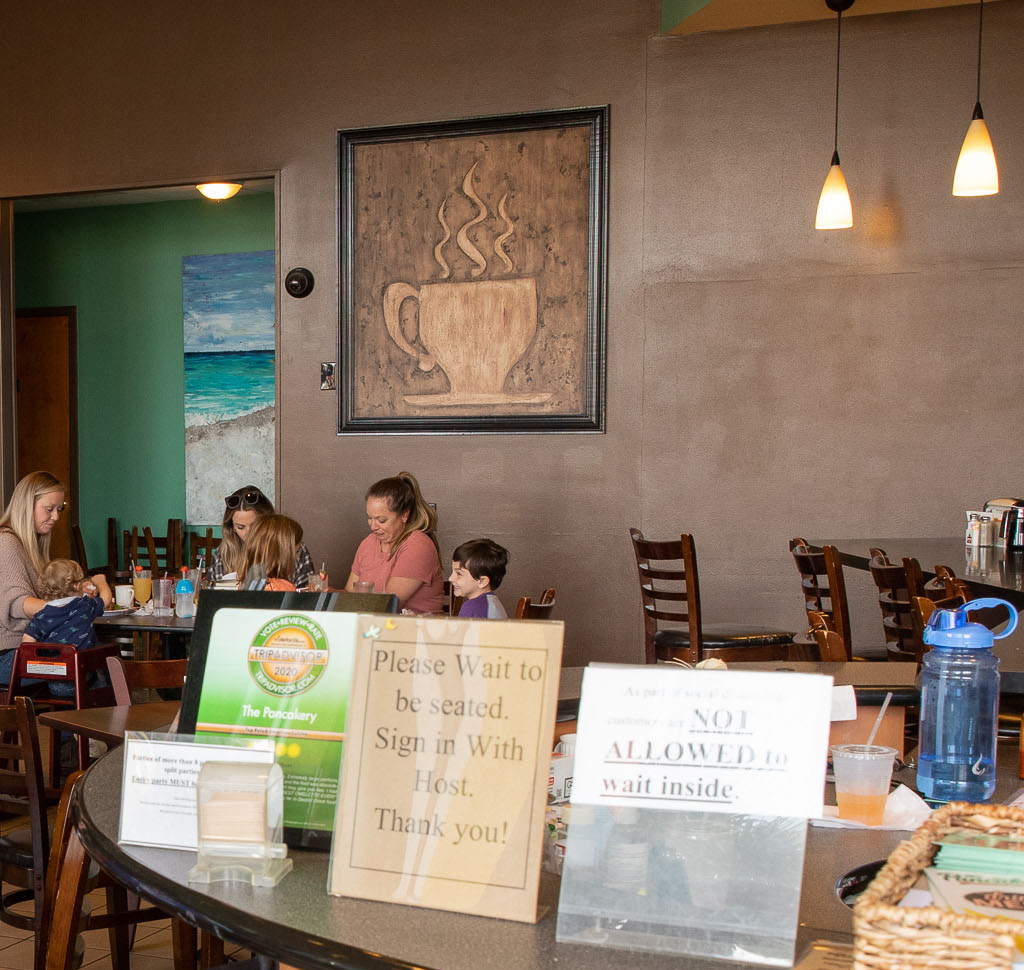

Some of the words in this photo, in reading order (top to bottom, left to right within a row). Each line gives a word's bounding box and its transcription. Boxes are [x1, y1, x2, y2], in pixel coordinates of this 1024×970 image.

[254, 648, 323, 662] TRIPADVISOR
[373, 649, 446, 676] Please
[455, 654, 512, 681] Wait
[520, 661, 543, 682] to
[274, 667, 298, 677] 2020
[242, 704, 261, 718] The
[263, 706, 318, 725] Pancakery
[395, 689, 422, 713] be
[429, 696, 509, 720] seated.
[691, 708, 754, 730] NOT
[375, 727, 425, 758] Sign
[436, 731, 456, 756] in
[467, 734, 524, 762] With
[603, 739, 756, 765] ALLOWED
[764, 749, 790, 766] to
[414, 769, 474, 798] Host.
[601, 774, 652, 795] wait
[661, 776, 740, 800] inside.
[374, 807, 448, 838] Thank
[451, 820, 508, 845] you!
